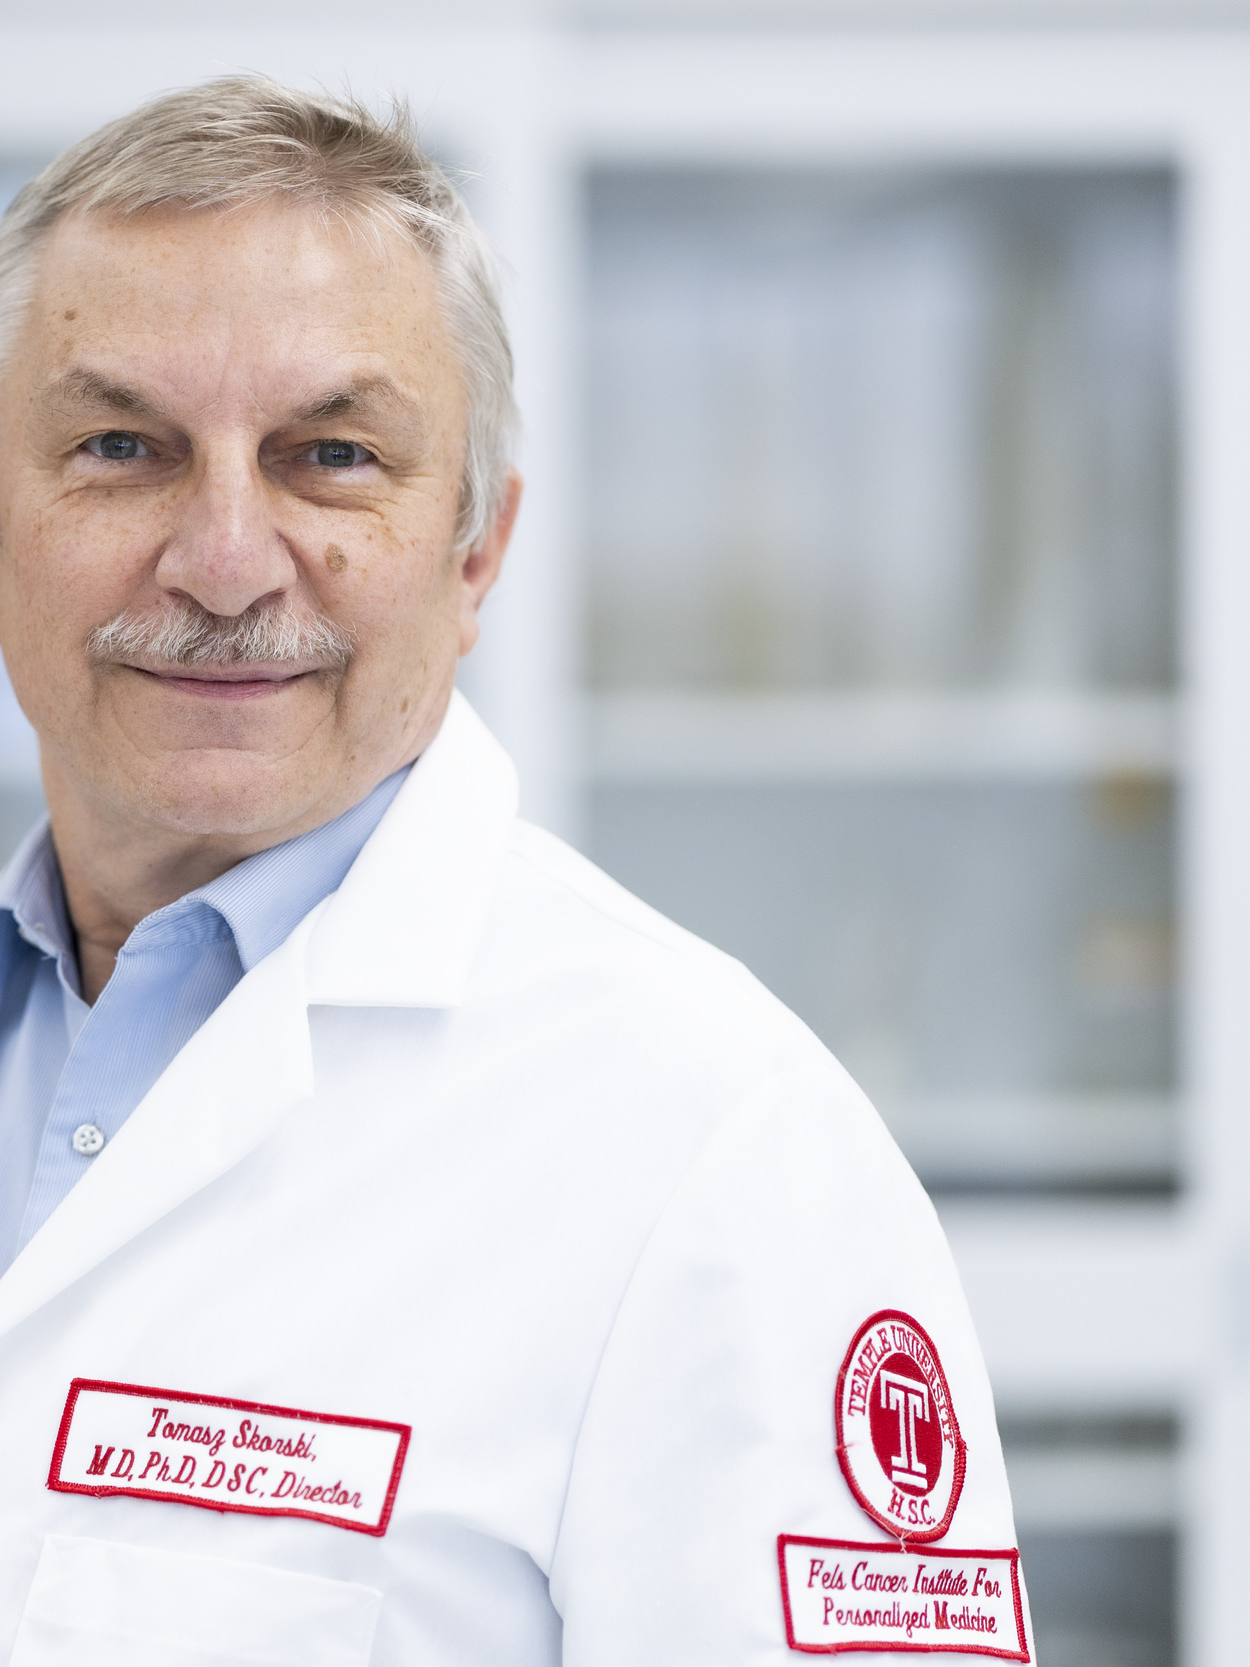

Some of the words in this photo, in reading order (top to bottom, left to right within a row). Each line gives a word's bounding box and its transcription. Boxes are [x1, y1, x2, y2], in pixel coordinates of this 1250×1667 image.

[847, 1327, 893, 1417] TEMPLE
[890, 1325, 956, 1449] UNIVERSITY
[147, 1407, 226, 1456] Tomasz
[232, 1419, 317, 1462] Skorski,
[879, 1368, 931, 1489] T
[270, 1471, 363, 1509] Director
[807, 1558, 847, 1590] Fels
[851, 1561, 908, 1593] Cancer
[912, 1564, 968, 1597] Institute
[971, 1567, 1002, 1599] For
[822, 1596, 930, 1638] Personalized
[933, 1600, 998, 1634] Medicine
